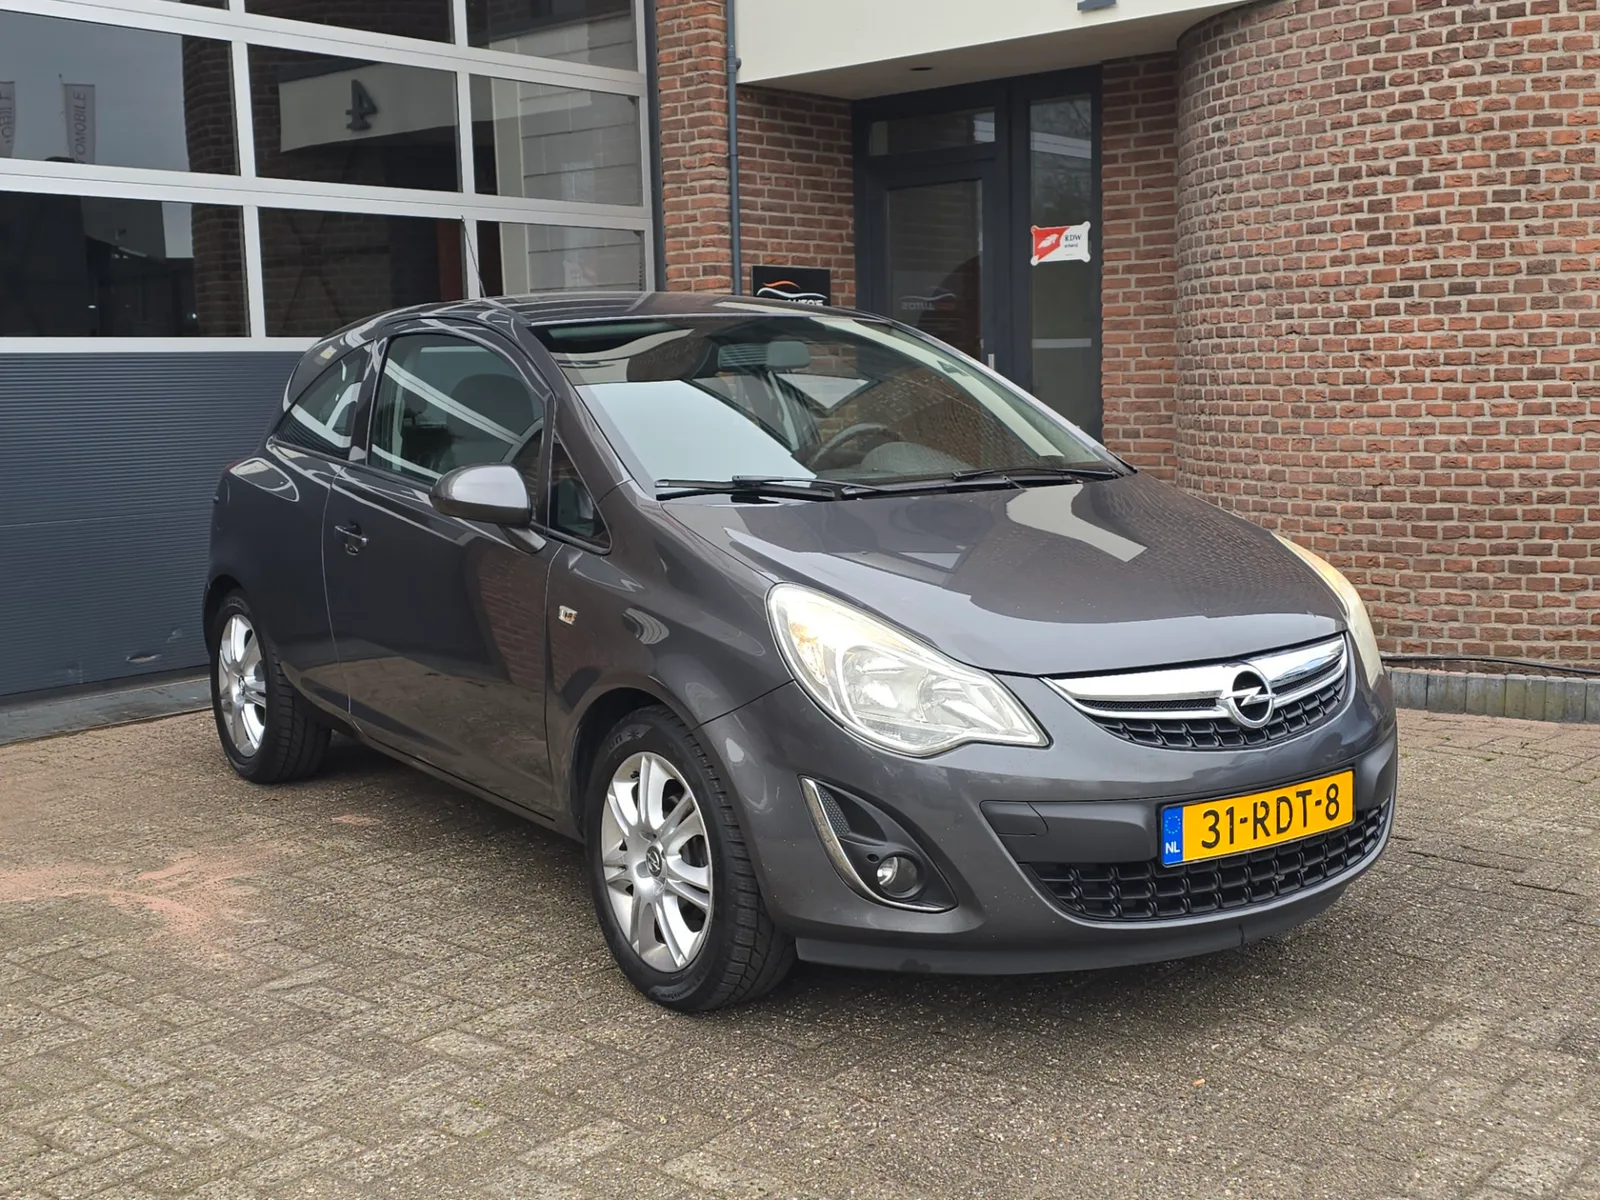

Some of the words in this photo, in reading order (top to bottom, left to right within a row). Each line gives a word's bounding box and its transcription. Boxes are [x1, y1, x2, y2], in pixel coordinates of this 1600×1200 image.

[73, 89, 87, 162] OMOBILE
[1064, 233, 1083, 242] RDW
[1201, 783, 1340, 849] 31-RDT-8
[1165, 841, 1181, 854] NL
